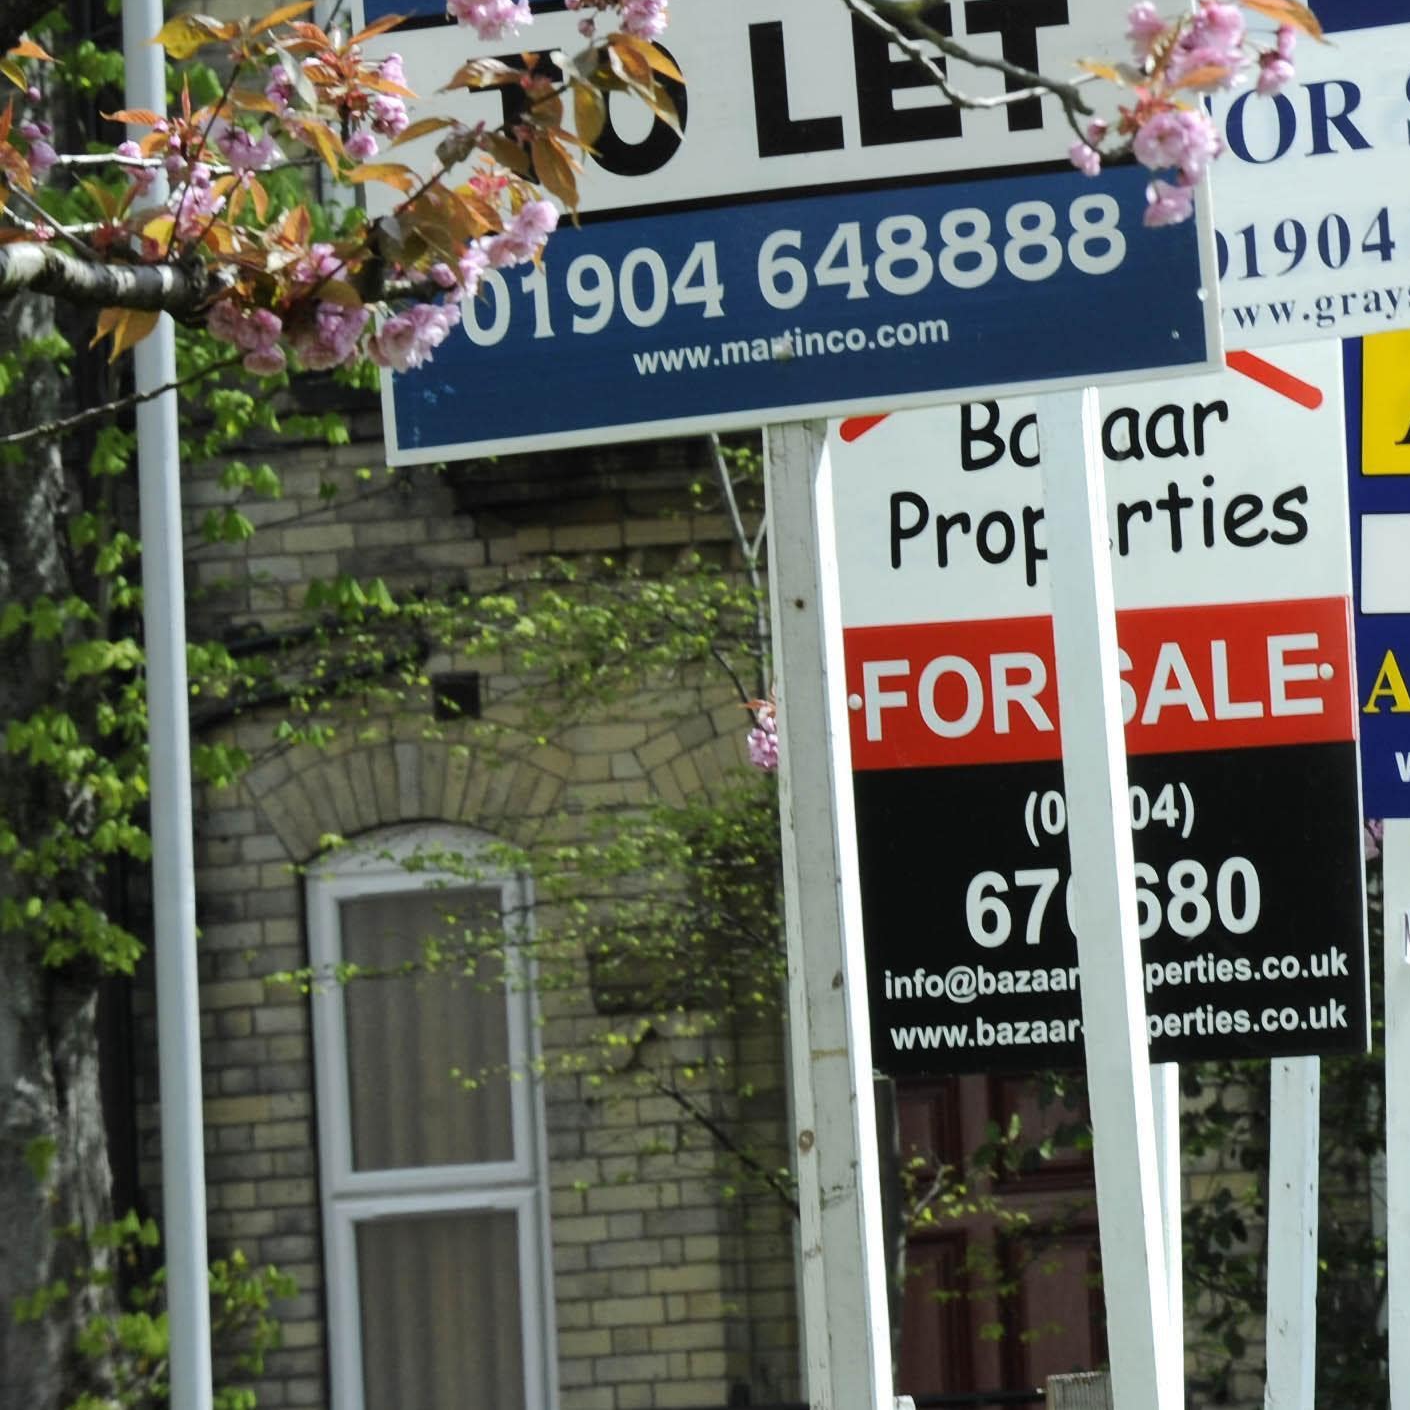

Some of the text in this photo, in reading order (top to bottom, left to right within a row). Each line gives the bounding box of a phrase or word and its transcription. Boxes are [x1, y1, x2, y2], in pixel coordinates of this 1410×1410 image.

[1204, 79, 1375, 165] OR
[461, 193, 1127, 347] 01904 648888
[631, 314, 950, 377] www.martinco.com
[960, 398, 1229, 472] Baaar
[889, 474, 1310, 587] Proprties
[862, 651, 1055, 743] FOR
[1024, 781, 1195, 848] (004)
[964, 854, 1261, 949] 67680
